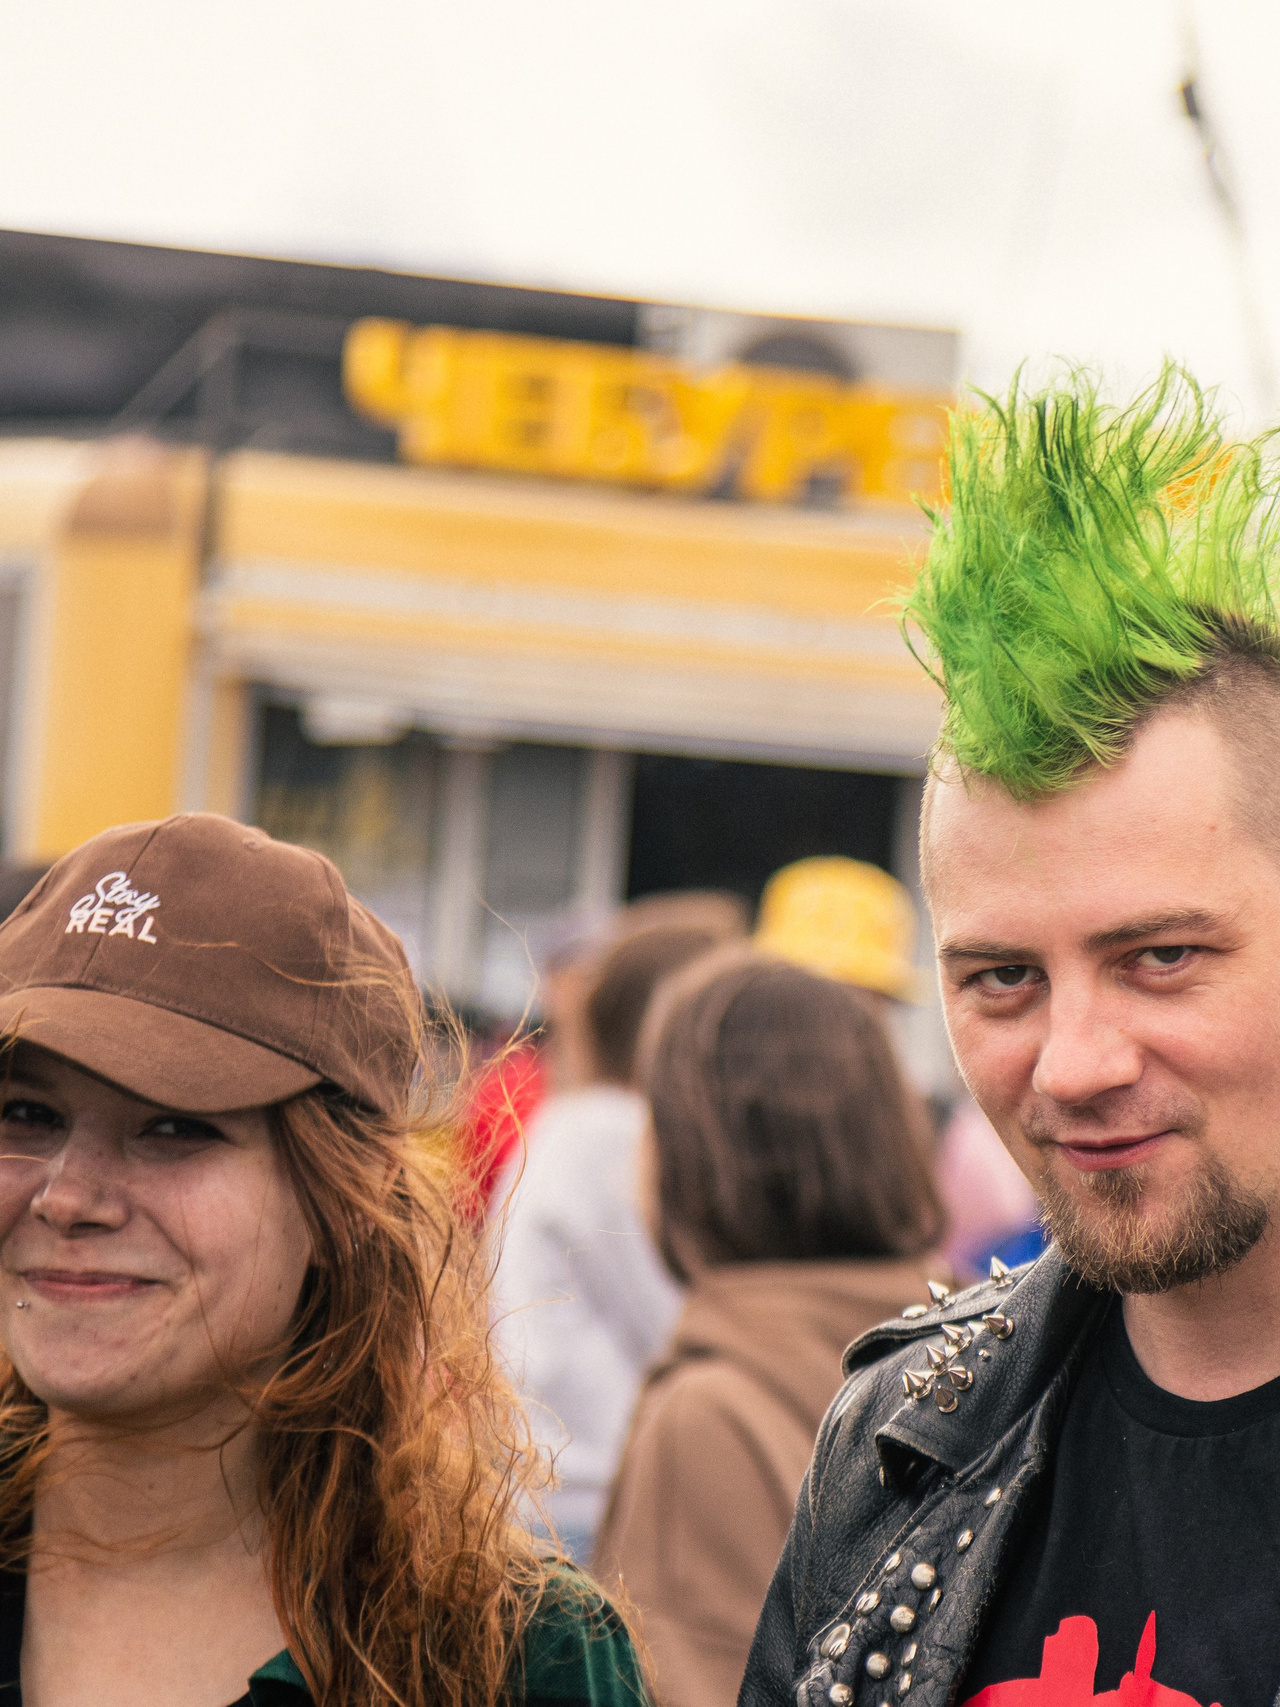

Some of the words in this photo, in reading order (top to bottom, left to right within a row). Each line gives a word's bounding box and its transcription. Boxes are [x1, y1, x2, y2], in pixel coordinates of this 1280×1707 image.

[344, 316, 990, 504] ЧЕБУРЕ
[70, 871, 160, 924] Stay
[65, 908, 157, 944] REAL
